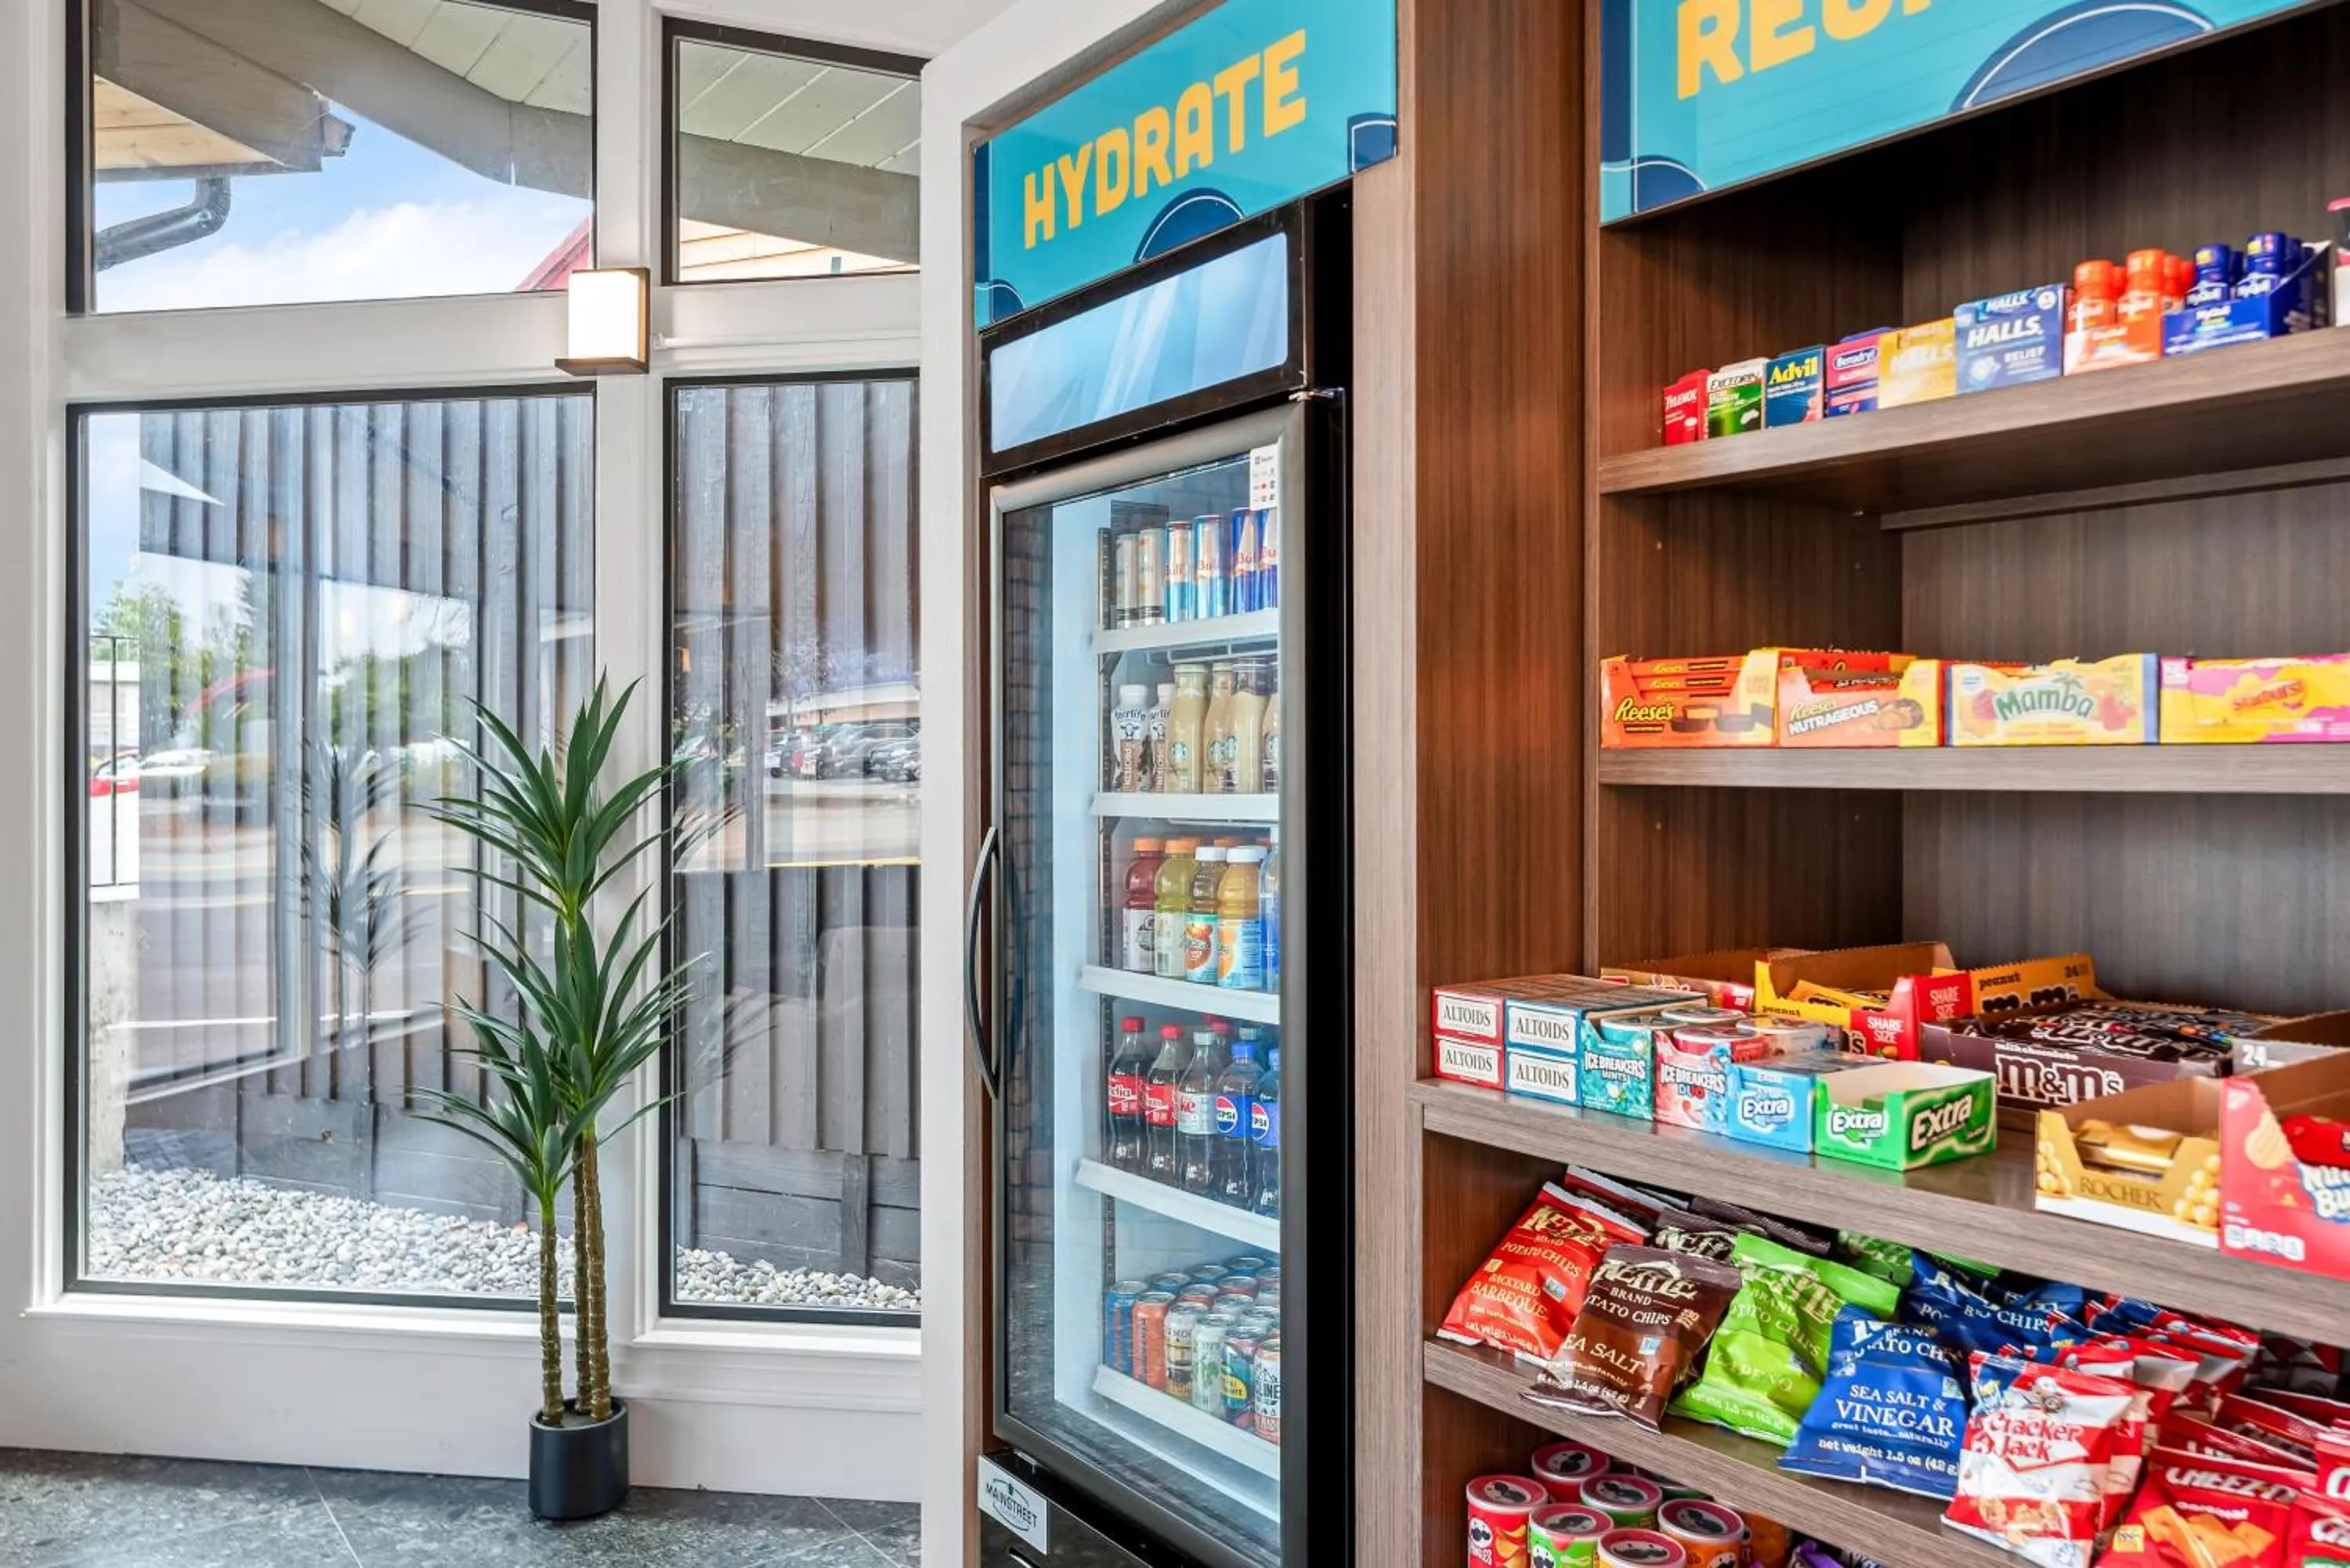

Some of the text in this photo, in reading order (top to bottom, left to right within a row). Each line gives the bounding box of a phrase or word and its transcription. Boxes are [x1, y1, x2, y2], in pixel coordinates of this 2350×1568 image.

[1677, 0, 1932, 99] RE
[1024, 29, 1307, 250] HYDRATE
[1986, 294, 2029, 312] HALLS
[1967, 315, 2040, 349] HALLS
[1769, 356, 1818, 385] Advil
[1615, 697, 1674, 722] Reese's
[1789, 700, 1879, 735] NUTRAGEOUS
[1995, 686, 2094, 721] Mamba
[1979, 972, 2021, 991] peanut
[1930, 987, 1961, 1005] SHARE
[1444, 1003, 1491, 1027] ALTOIDS
[1516, 1017, 1570, 1041] ALTOIDS
[1867, 1015, 1904, 1032] SHARE
[1873, 1030, 1897, 1044] SIZE
[1445, 1049, 1492, 1072] ALTOIDS
[1585, 1050, 1646, 1080] ICE BREAKERS
[2243, 1044, 2267, 1067] 24
[1516, 1064, 1570, 1089] ALTOIDS
[1661, 1063, 1726, 1096] ICE BREAKERS
[1678, 1082, 1705, 1099] DUO
[1996, 1054, 2124, 1106] m&m's
[1741, 1097, 1790, 1118] Extra
[1831, 1109, 1884, 1133] Extra
[1911, 1093, 1972, 1151] Extra
[2080, 1176, 2162, 1209] ROCHER
[1541, 1246, 1582, 1278] CHIPS
[1488, 1273, 1541, 1297] BACKYARD
[1611, 1286, 1652, 1306] BRAND
[1470, 1281, 1549, 1320] BARBEQUE
[1585, 1295, 1629, 1319] TATO
[1632, 1309, 1672, 1327] CHIPS
[1564, 1334, 1586, 1352] EA
[1590, 1342, 1645, 1375] SALT
[1849, 1384, 1947, 1412] SEA SALT &
[1835, 1399, 1956, 1438] VINEGAR
[1988, 1412, 2084, 1443] Cracker
[1818, 1439, 1840, 1451] net
[1841, 1442, 1883, 1459] weight
[1885, 1449, 1904, 1463] 1.5
[1996, 1435, 2052, 1462] Jack
[985, 1483, 1038, 1528] MAINSTREET
